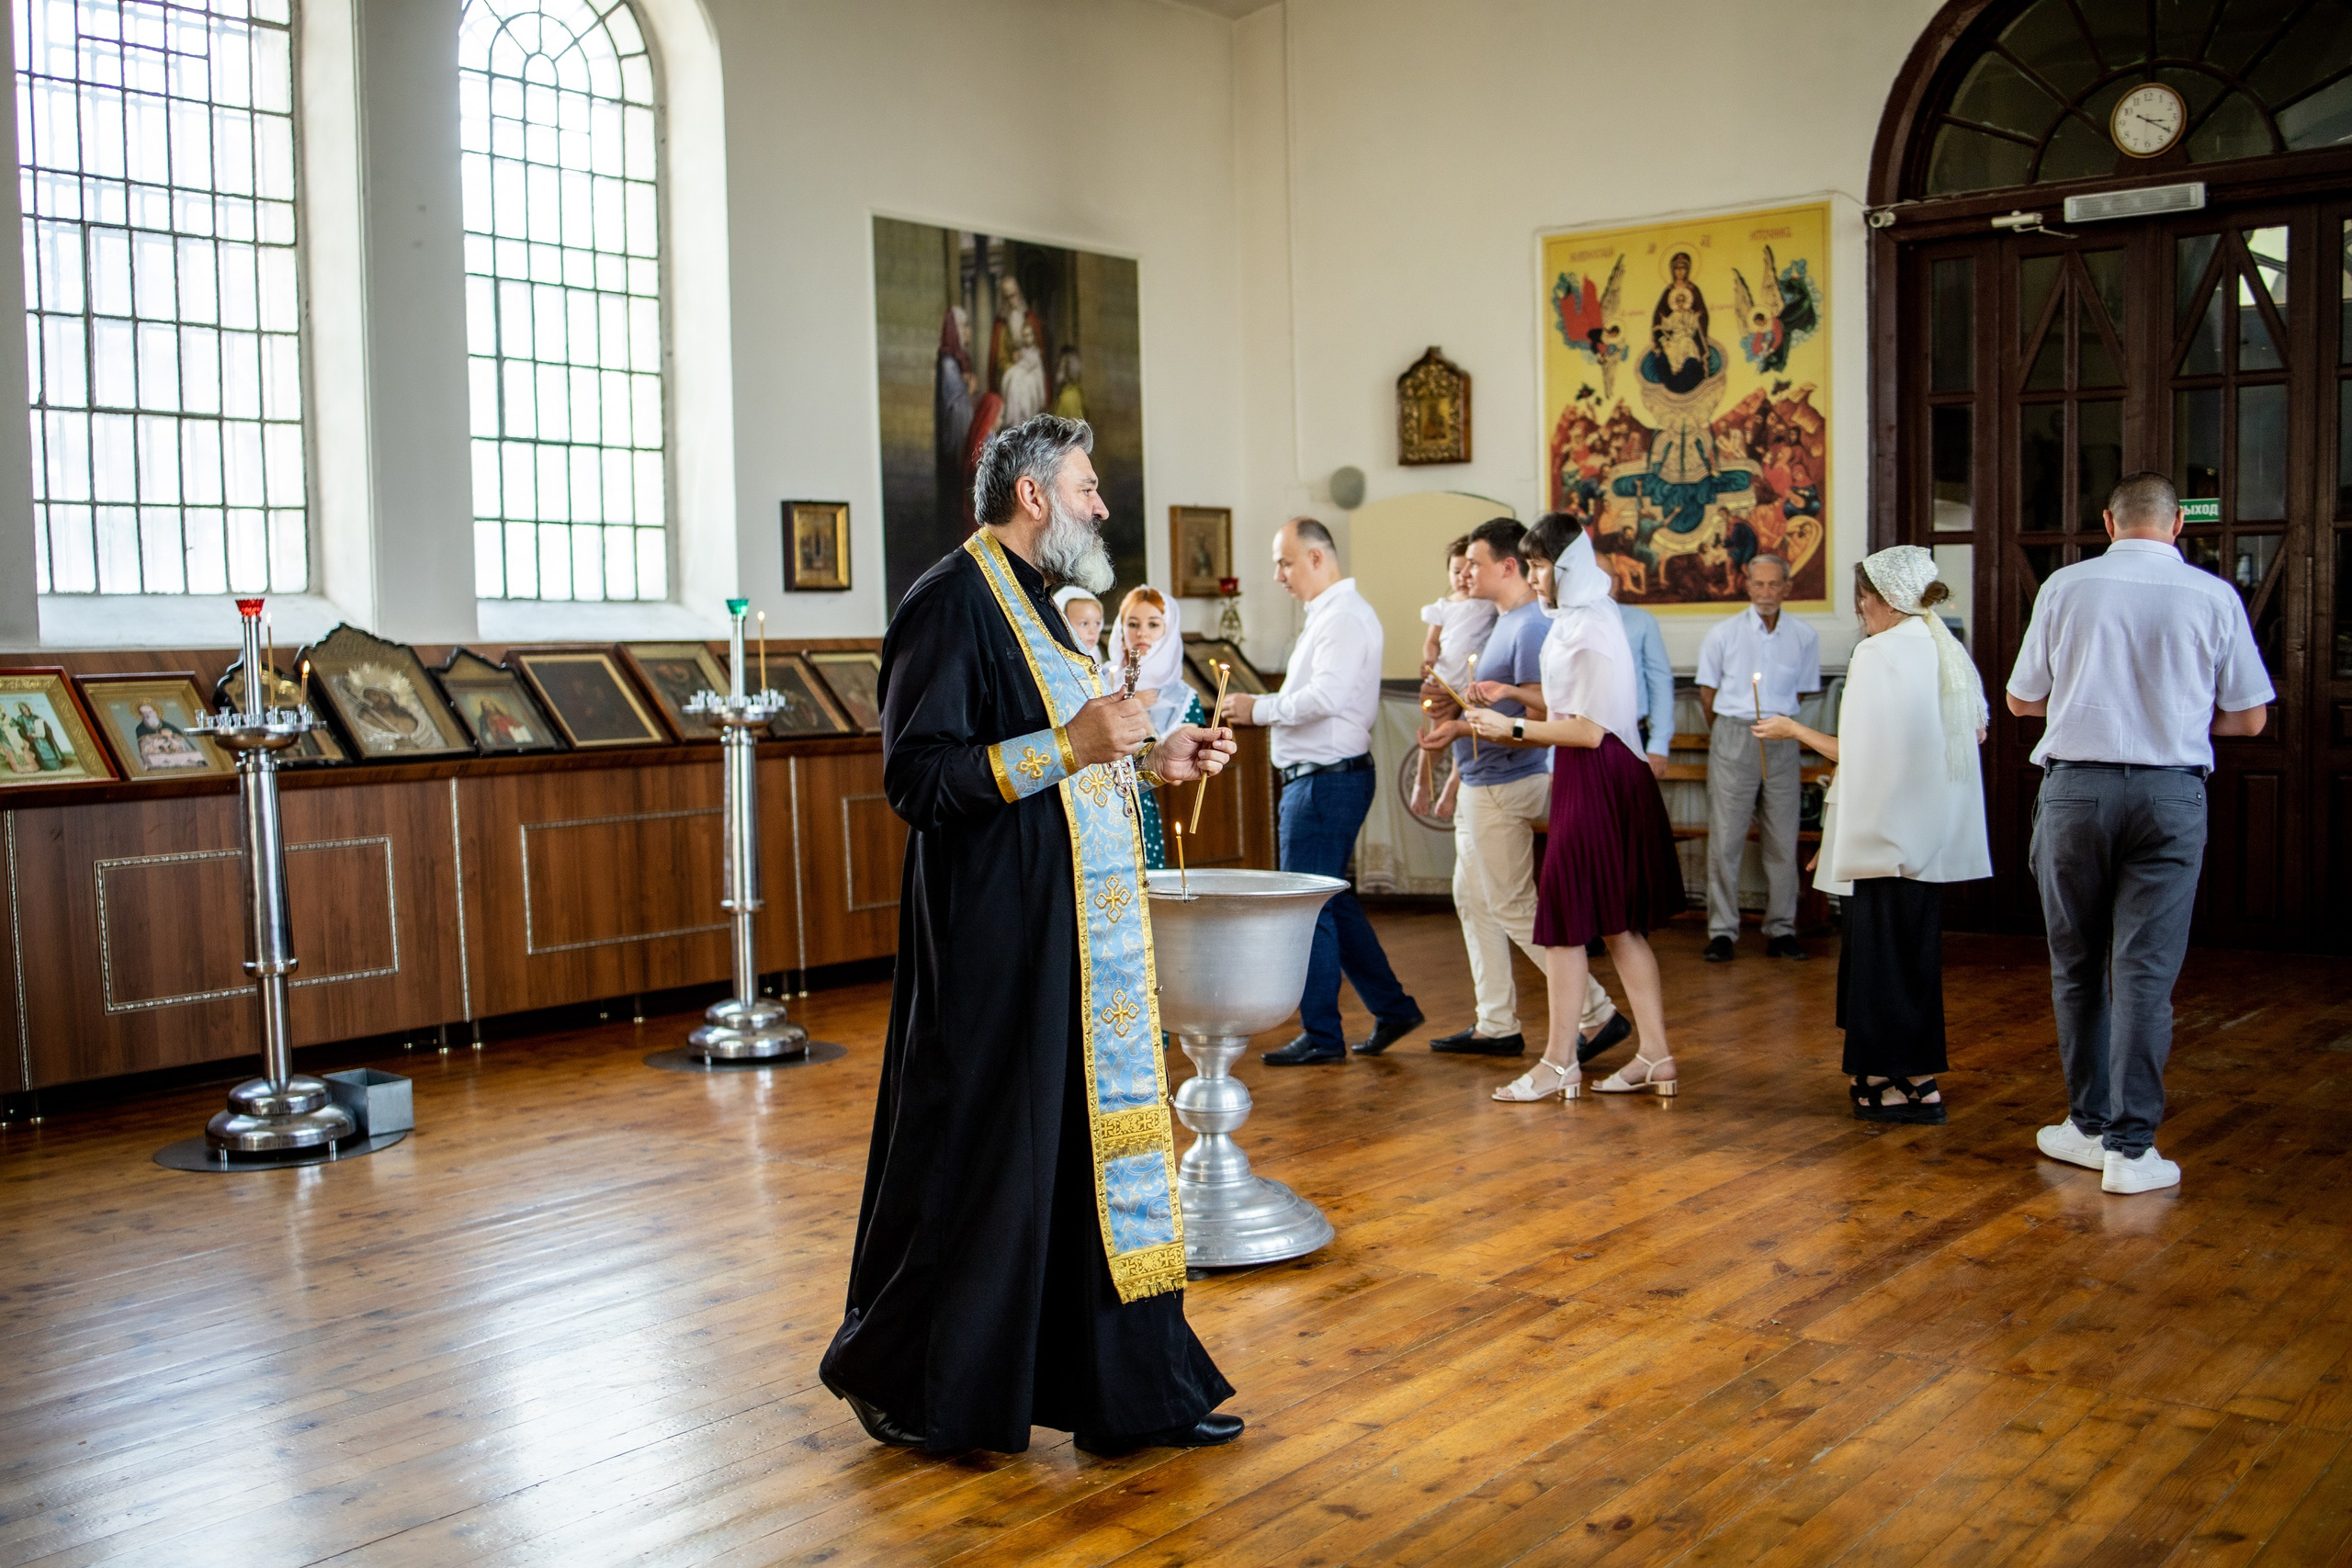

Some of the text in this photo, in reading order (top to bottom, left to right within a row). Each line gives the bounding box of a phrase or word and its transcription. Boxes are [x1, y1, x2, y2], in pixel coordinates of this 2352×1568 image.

[2133, 97, 2140, 107] 11
[2143, 92, 2154, 102] 12
[2167, 101, 2174, 111] 2
[2124, 107, 2133, 117] 10
[2133, 138, 2139, 147] 7
[2157, 134, 2164, 144] 5
[2180, 503, 2219, 516] ЫХОД
